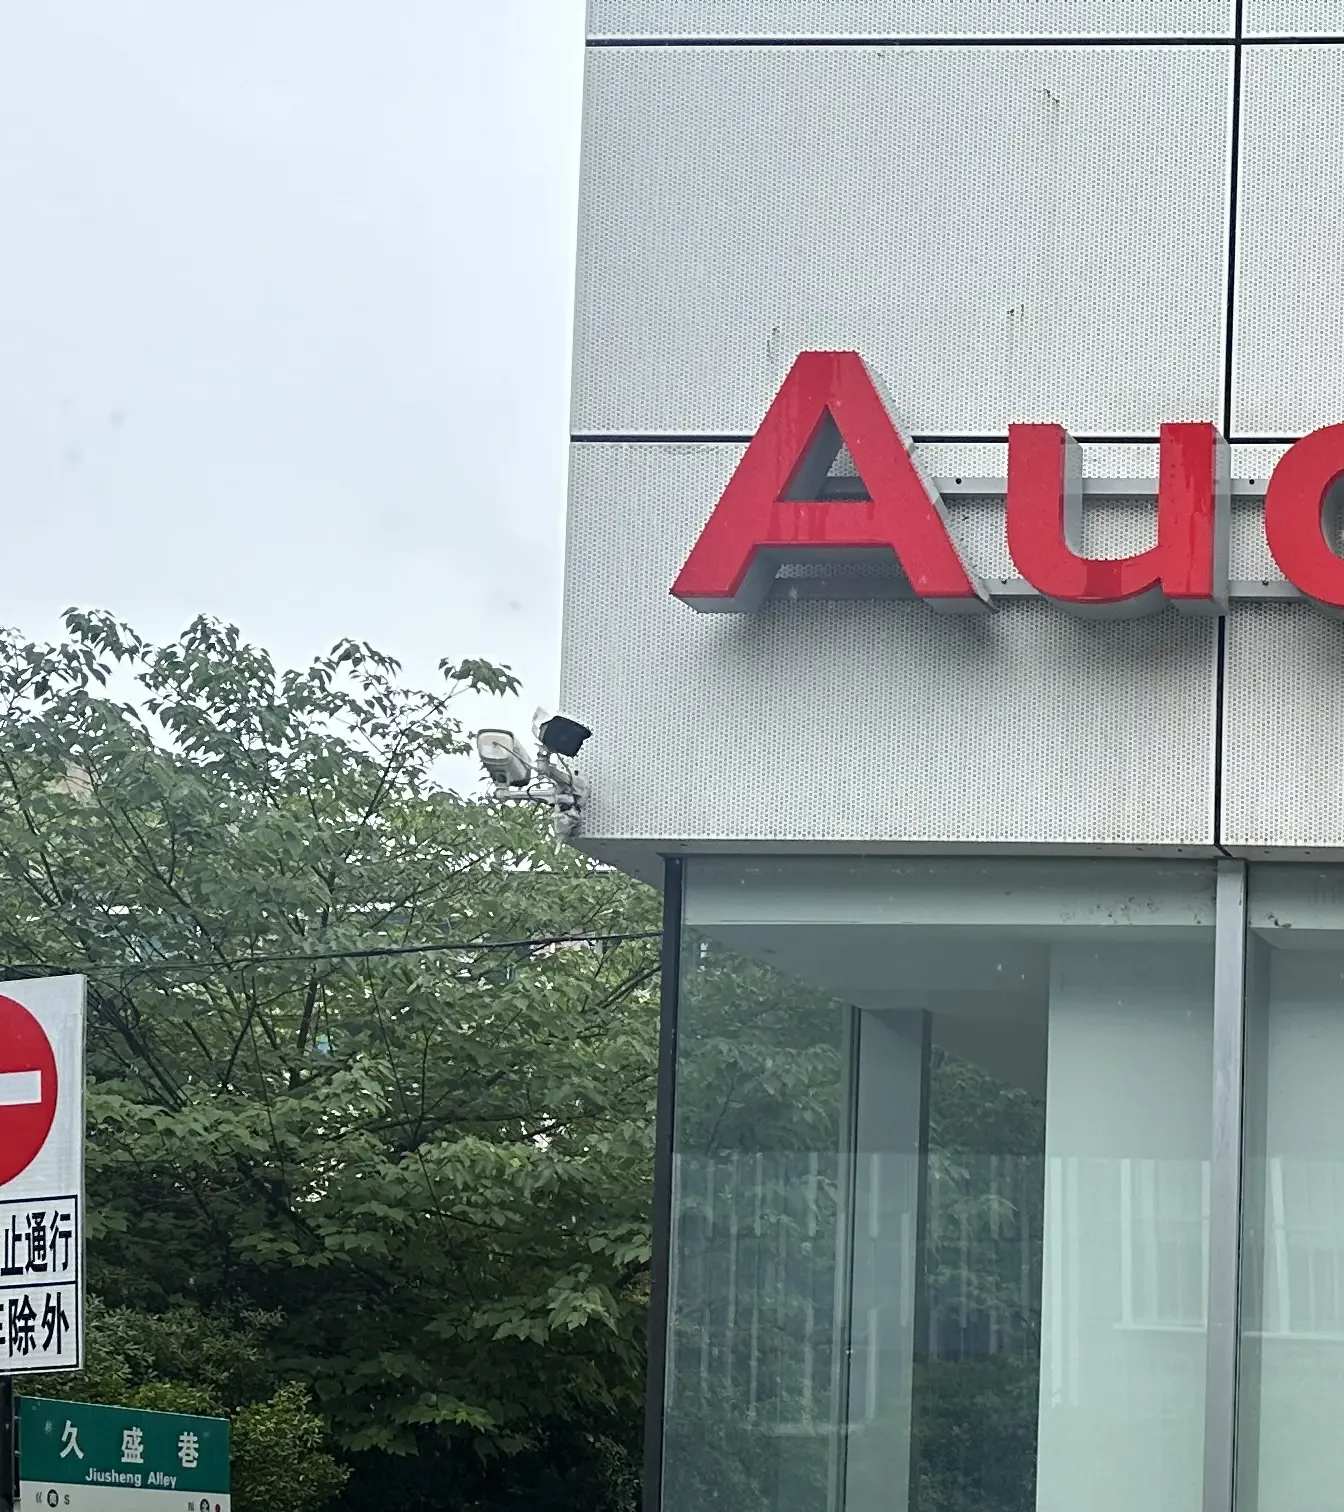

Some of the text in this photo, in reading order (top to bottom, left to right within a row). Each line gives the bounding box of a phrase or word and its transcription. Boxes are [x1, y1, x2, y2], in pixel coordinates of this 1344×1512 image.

[1, 1210, 72, 1276] 止通行
[0, 1292, 70, 1357] 除外
[60, 1420, 199, 1468] 久盛巷
[64, 1494, 70, 1505] S
[85, 1467, 177, 1489] Jiusheng Alley
